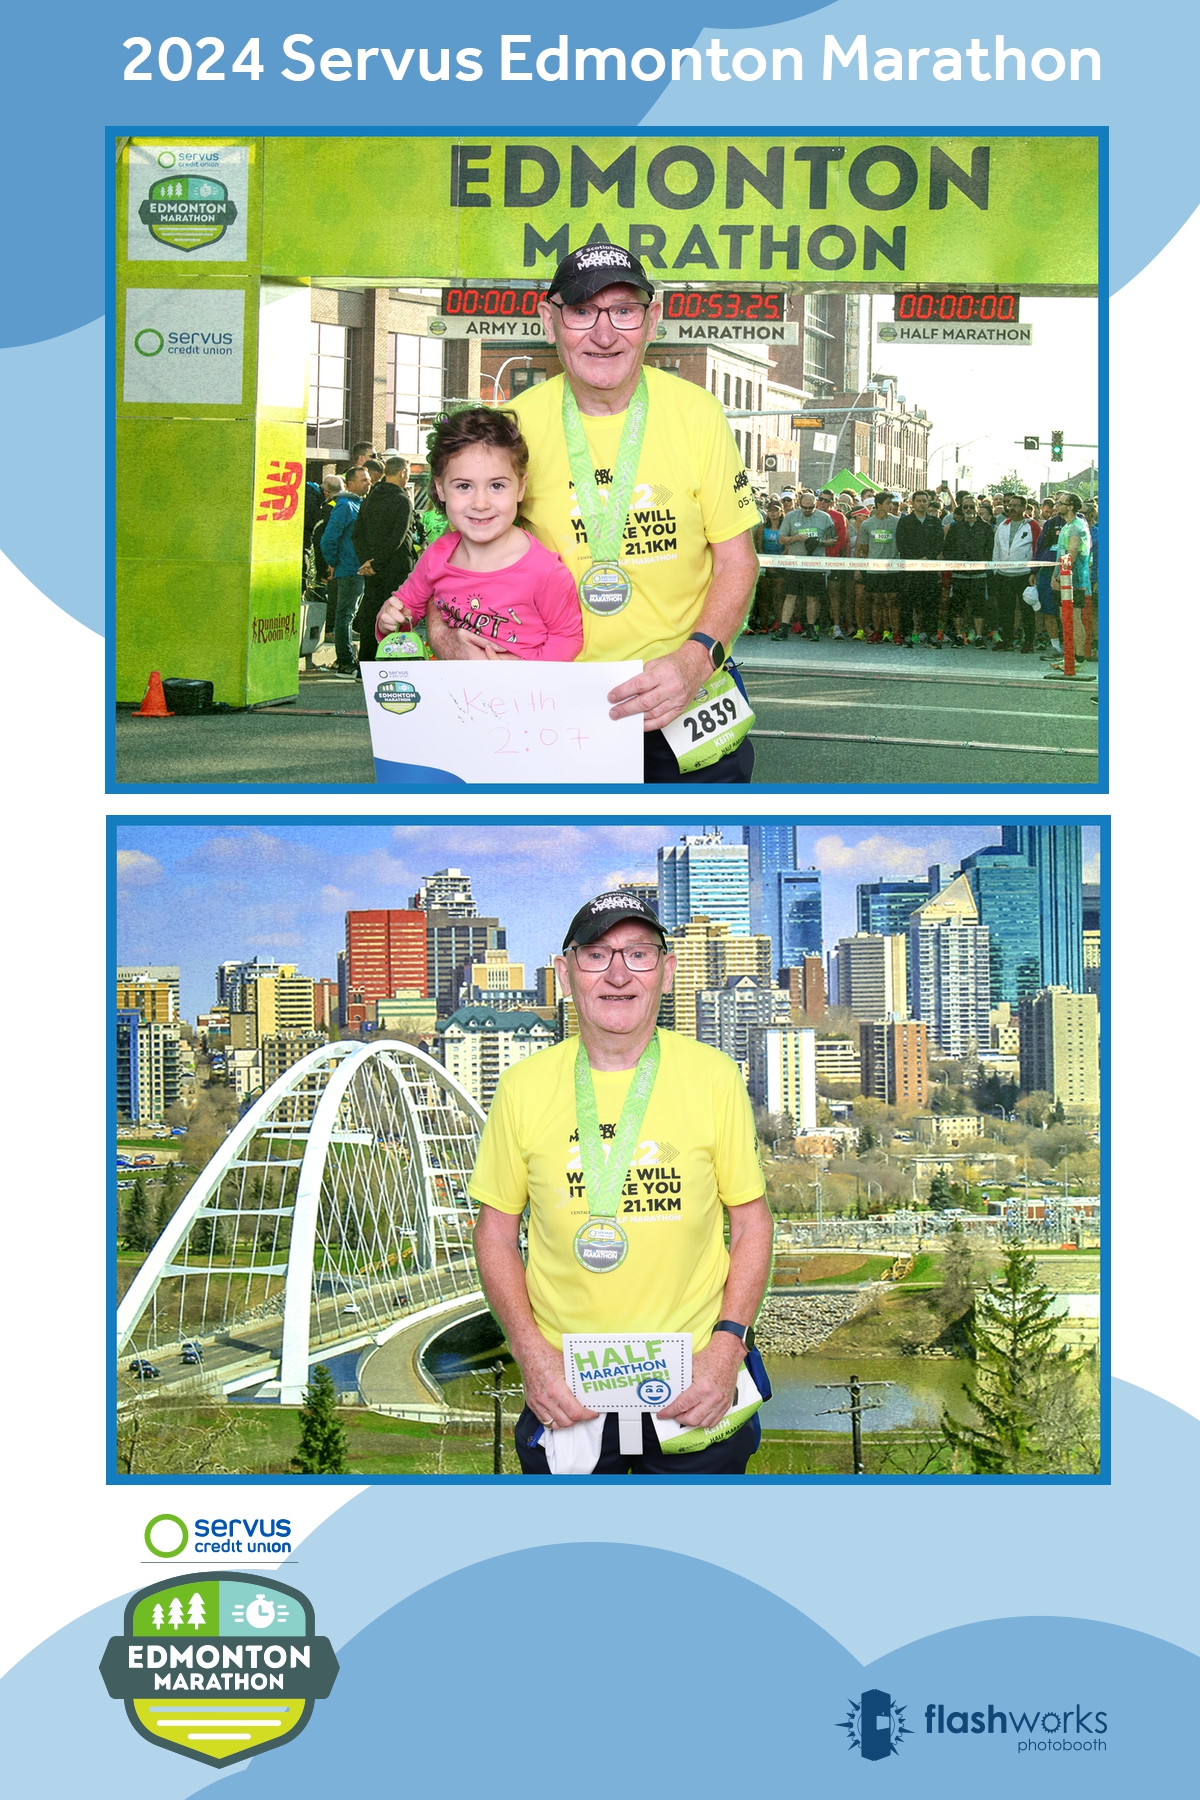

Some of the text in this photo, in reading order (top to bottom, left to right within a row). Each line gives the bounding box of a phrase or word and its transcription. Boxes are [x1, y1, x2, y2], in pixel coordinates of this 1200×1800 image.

[178, 152, 219, 161] servus
[450, 144, 990, 211] EDMONTON
[149, 203, 226, 213] EDMONTON
[160, 214, 215, 222] MARATHON
[465, 321, 546, 336] ARMY 10
[678, 325, 785, 340] MARATHON
[900, 328, 1031, 341] HALF MARATHON
[168, 332, 233, 345] servus
[168, 345, 232, 355] credit union
[633, 509, 676, 524] WILL
[640, 522, 676, 537] YOU
[625, 537, 677, 556] 21.1KM
[632, 553, 678, 566] MARATHON
[462, 687, 556, 715] Keith
[683, 697, 738, 743] 2839
[488, 726, 590, 754] 2:07
[713, 730, 735, 748] KEITH
[636, 1167, 681, 1181] WILL
[569, 1185, 586, 1198] IT
[643, 1181, 681, 1195] YOU
[623, 1198, 681, 1213] 21.1KM
[630, 1214, 681, 1223] MARATHON
[573, 1339, 662, 1372] HALF
[580, 1359, 667, 1382] MARATHON
[582, 1369, 670, 1394] FINISHER!
[709, 1433, 724, 1444] HALF
